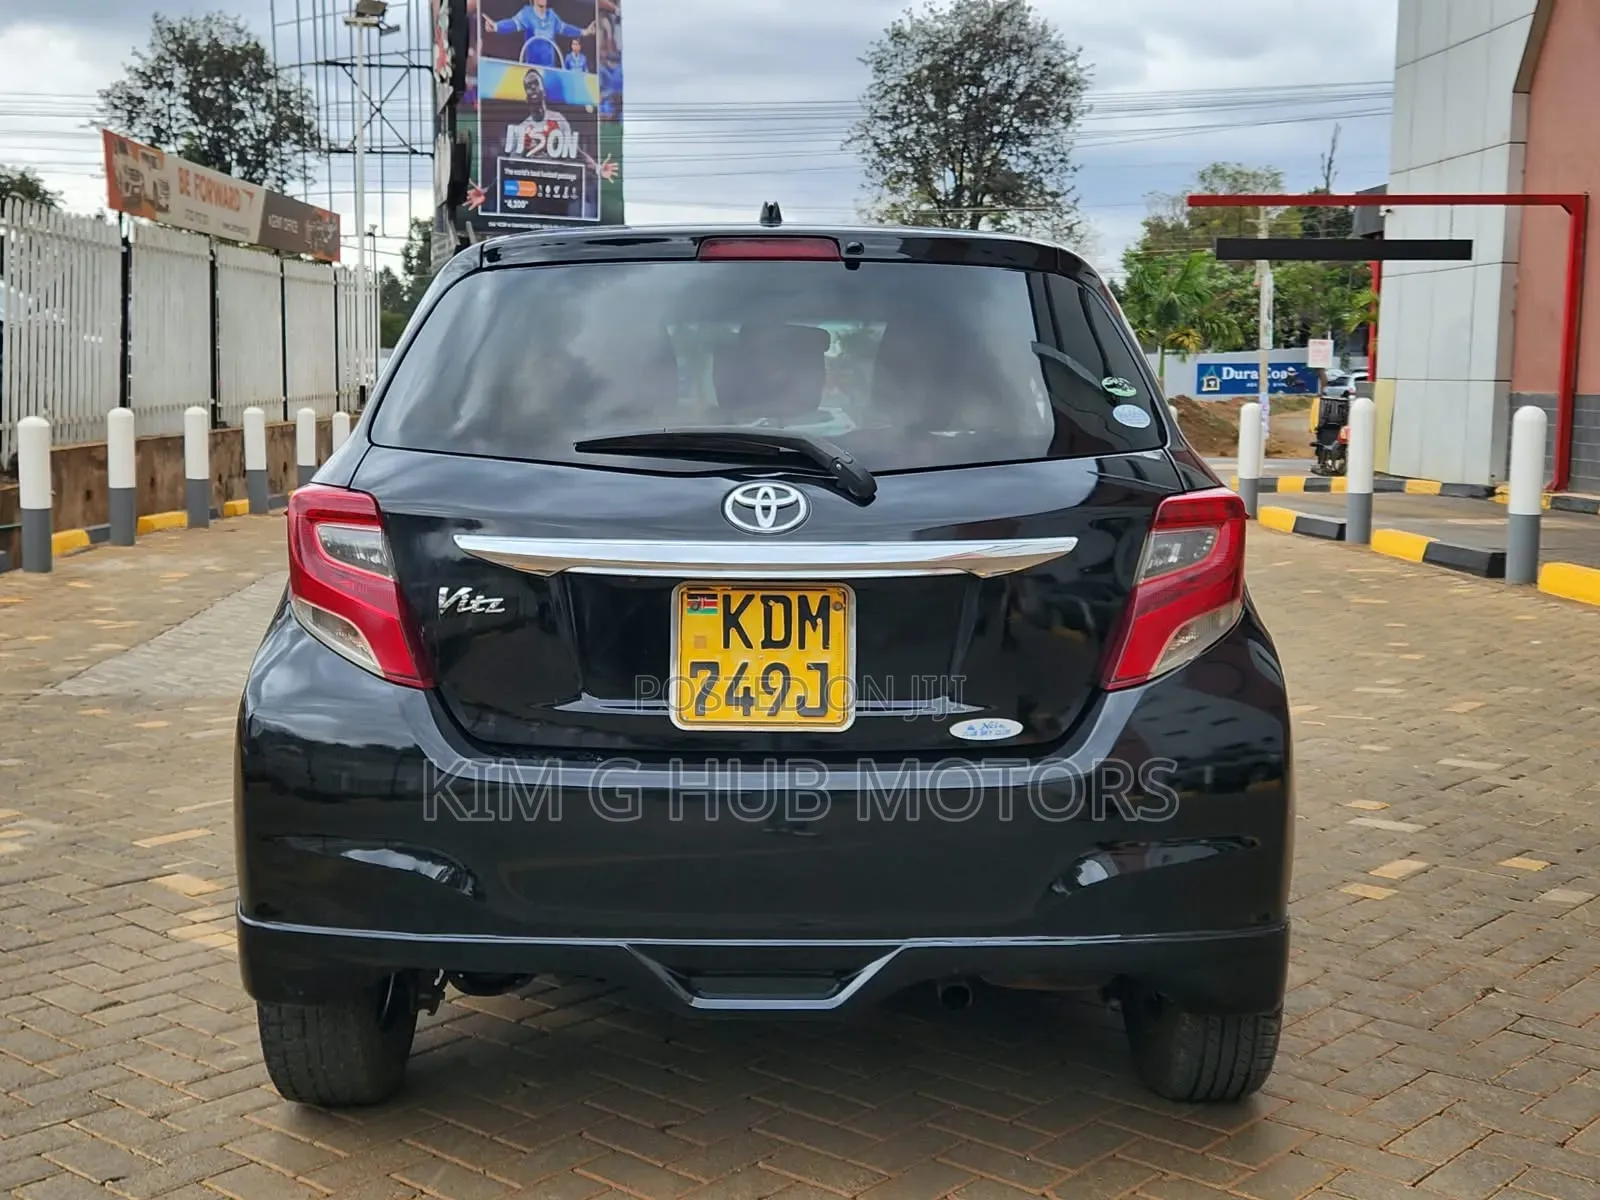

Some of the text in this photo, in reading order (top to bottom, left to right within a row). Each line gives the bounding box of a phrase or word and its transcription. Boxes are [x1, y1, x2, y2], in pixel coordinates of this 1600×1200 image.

[178, 167, 240, 212] BE FORWARD
[438, 586, 506, 615] Vitz
[722, 594, 831, 650] KDM
[689, 660, 829, 718] 749J
